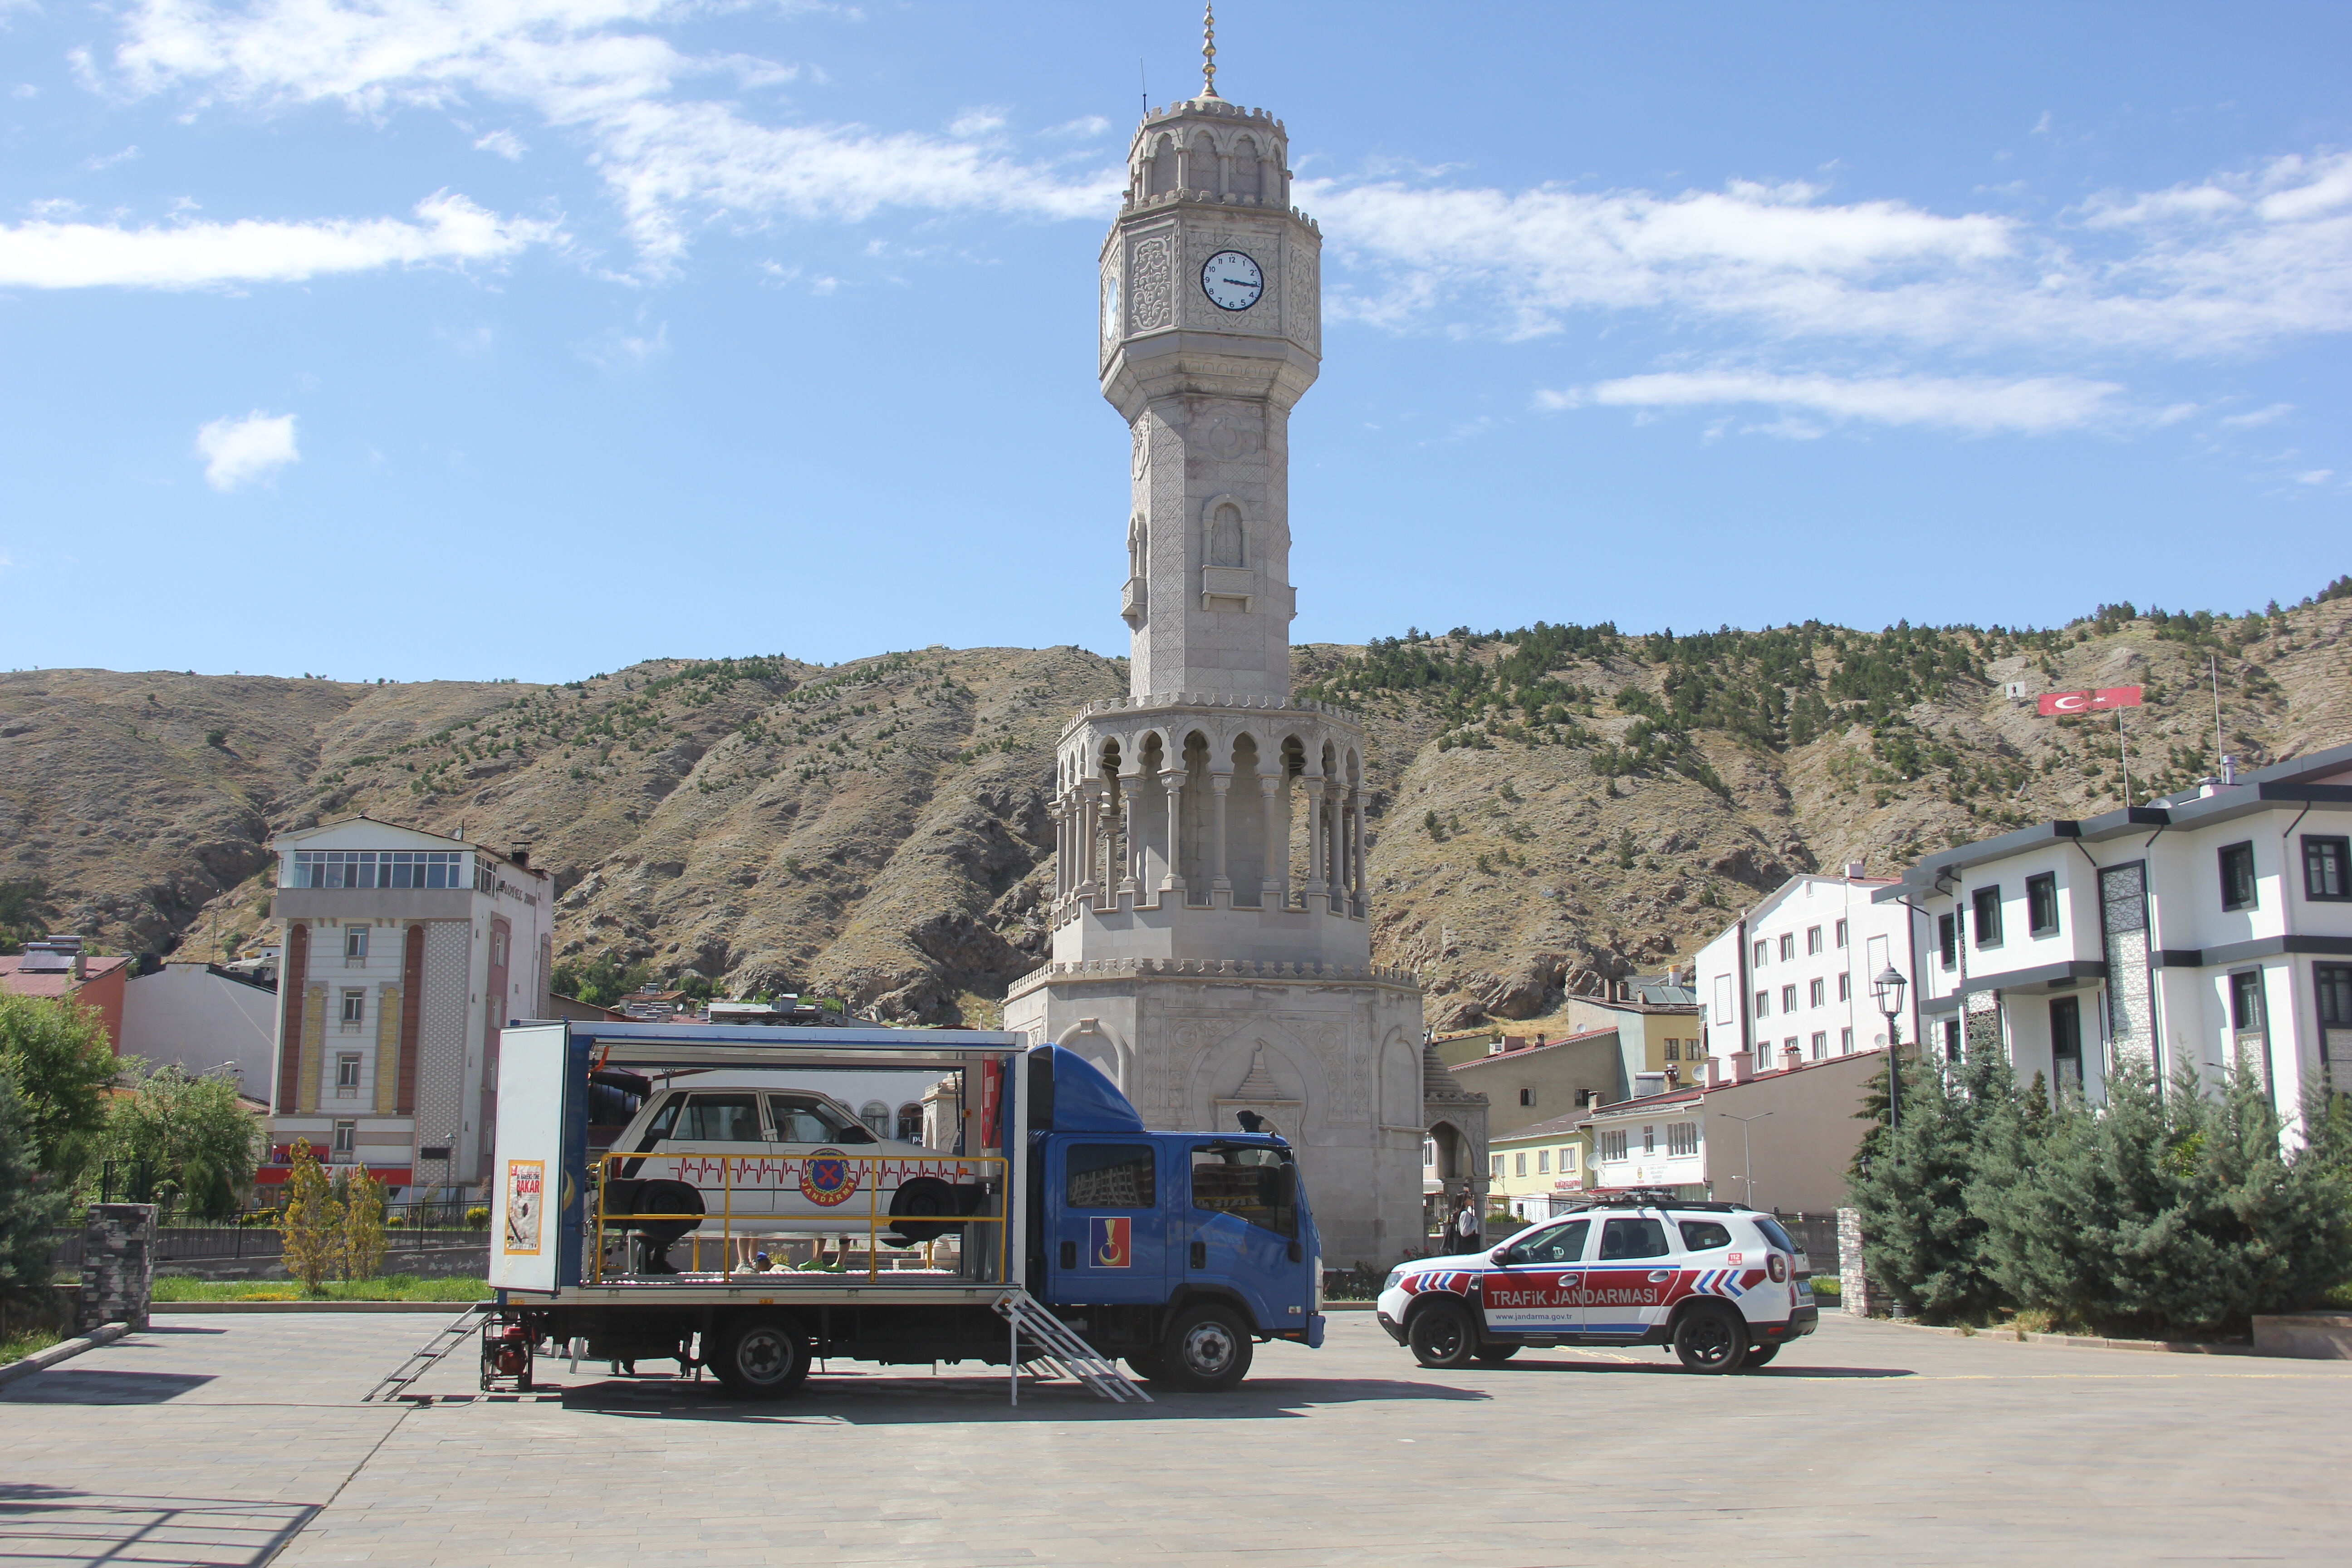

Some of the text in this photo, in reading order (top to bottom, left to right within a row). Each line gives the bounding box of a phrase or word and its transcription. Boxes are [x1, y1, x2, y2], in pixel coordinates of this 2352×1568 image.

[517, 1180, 539, 1193] BAKAR
[802, 1182, 855, 1203] JANDARMA
[1551, 1288, 1658, 1304] JANDARMASI
